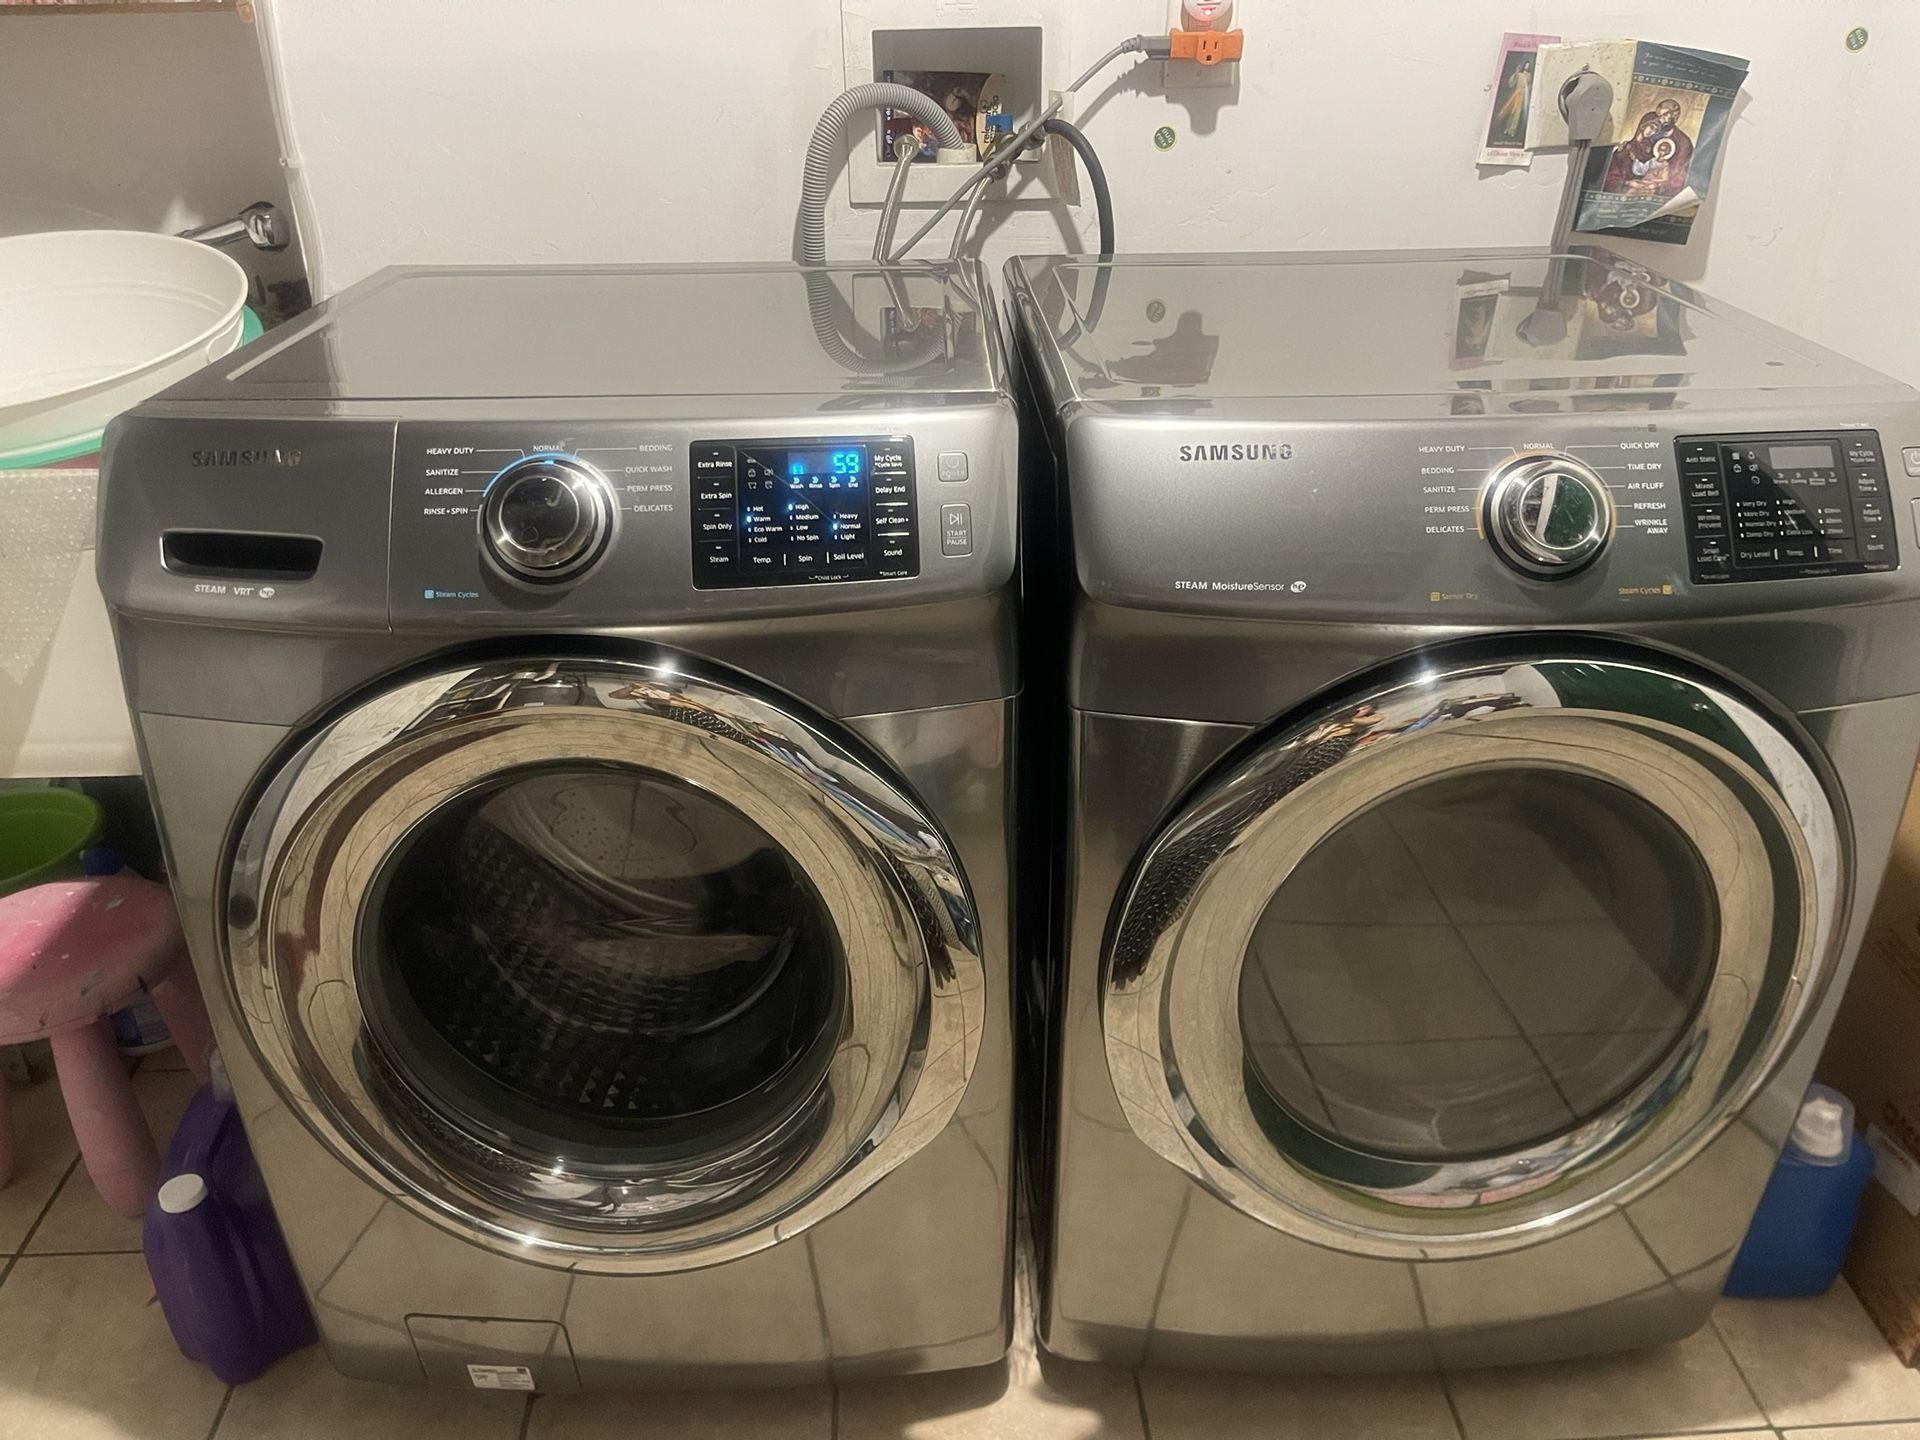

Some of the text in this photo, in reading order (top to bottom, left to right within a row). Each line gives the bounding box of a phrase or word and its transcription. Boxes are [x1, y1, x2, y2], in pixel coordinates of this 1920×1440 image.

[533, 444, 564, 452] NORMAL
[1620, 442, 1643, 450] QUICK
[1180, 444, 1292, 462] SAMSUNG
[192, 449, 303, 467] SAMSUNG
[885, 454, 902, 462] Cycle
[715, 460, 733, 468] Rinse
[833, 453, 859, 474] 59
[425, 468, 459, 476] SANITIZE
[625, 466, 648, 474] QUICK
[1641, 481, 1664, 489] FLUFF
[875, 485, 906, 494] Delay End
[718, 492, 732, 500] Spin
[634, 505, 673, 513] DELICATES
[1424, 506, 1446, 514] PERM
[703, 523, 733, 531] Spin Only
[840, 533, 856, 541] Light
[846, 552, 864, 560] Level
[883, 549, 903, 557] Sound
[798, 554, 813, 562] Spin
[194, 584, 226, 593] STEAM
[1175, 581, 1207, 590] STEAM
[1212, 582, 1285, 591] MoistureSensor
